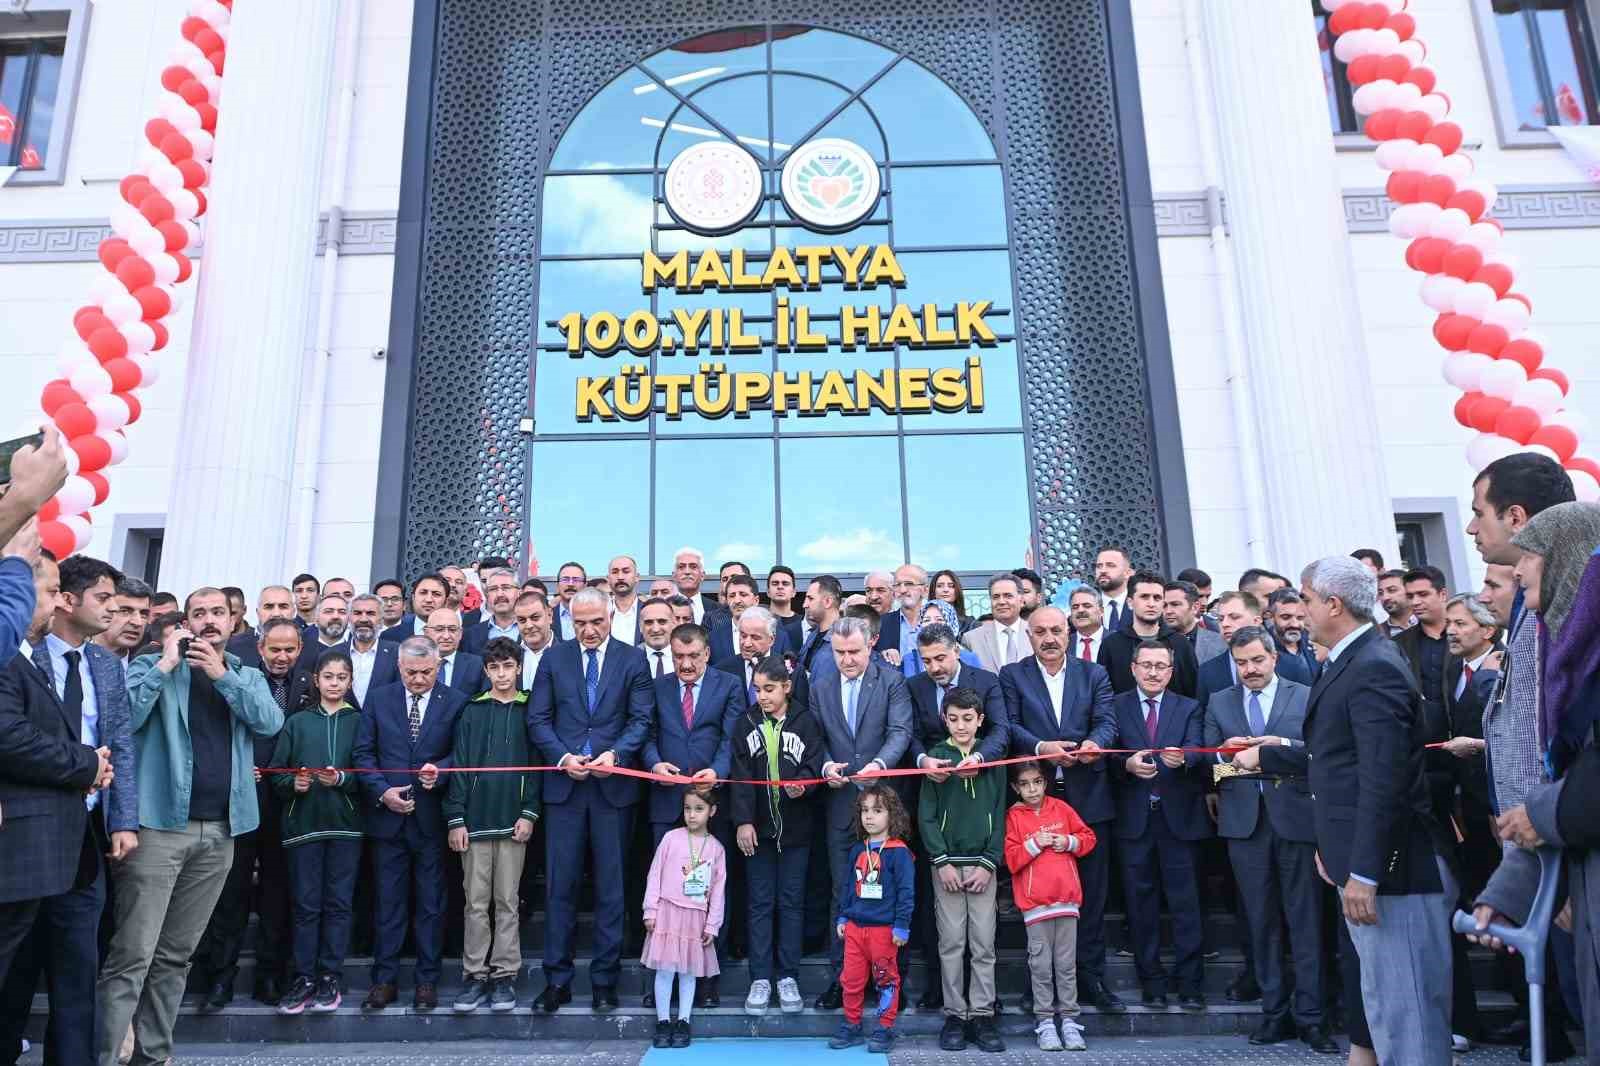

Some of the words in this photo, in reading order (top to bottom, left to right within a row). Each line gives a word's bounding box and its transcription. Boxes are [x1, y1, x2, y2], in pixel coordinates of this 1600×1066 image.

[641, 245, 906, 293] MALATYA
[557, 307, 762, 356] 100.YIL
[776, 297, 828, 352] İL
[841, 300, 998, 351] HALK
[575, 357, 985, 422] KÜTÜPHANESİ
